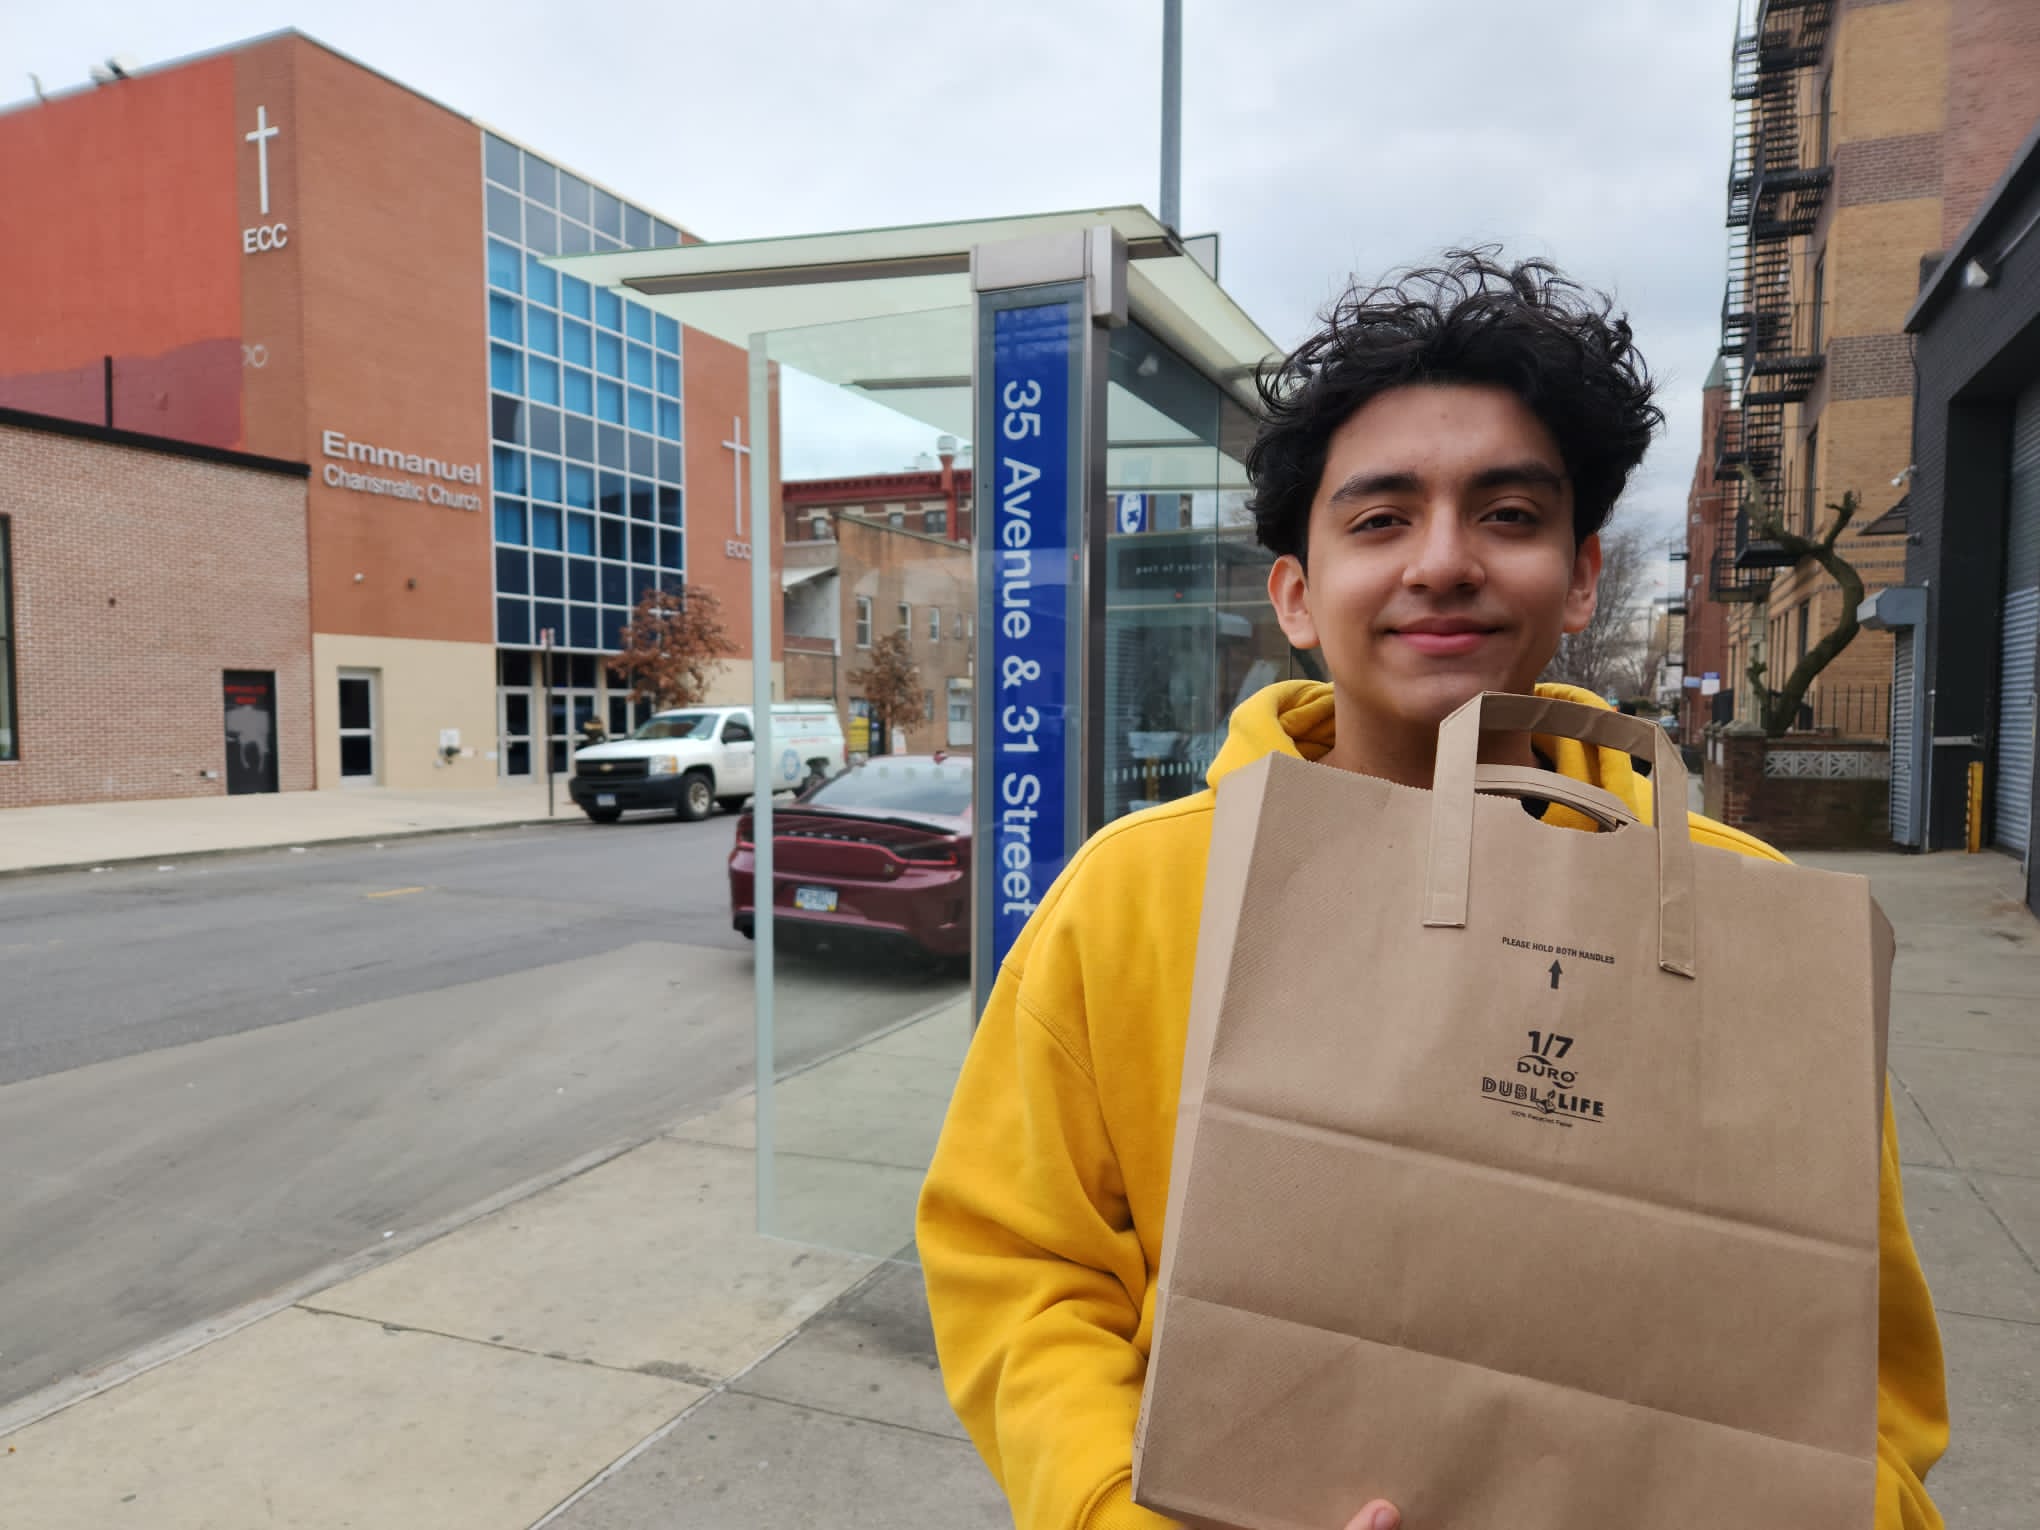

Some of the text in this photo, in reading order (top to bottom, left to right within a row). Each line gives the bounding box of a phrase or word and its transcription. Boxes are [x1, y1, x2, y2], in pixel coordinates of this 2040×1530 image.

[243, 223, 288, 254] ECC
[322, 430, 482, 485] Emmanuel
[323, 463, 482, 512] Charismatic Church
[1002, 379, 1042, 916] 35 Avenue & 31 Street
[1502, 936, 1616, 965] PLEASE HOLD BOTH HANDLES
[1528, 1031, 1574, 1058] 1/7
[1517, 1061, 1576, 1083] DURO
[1482, 1076, 1605, 1117] DUBL LIFE
